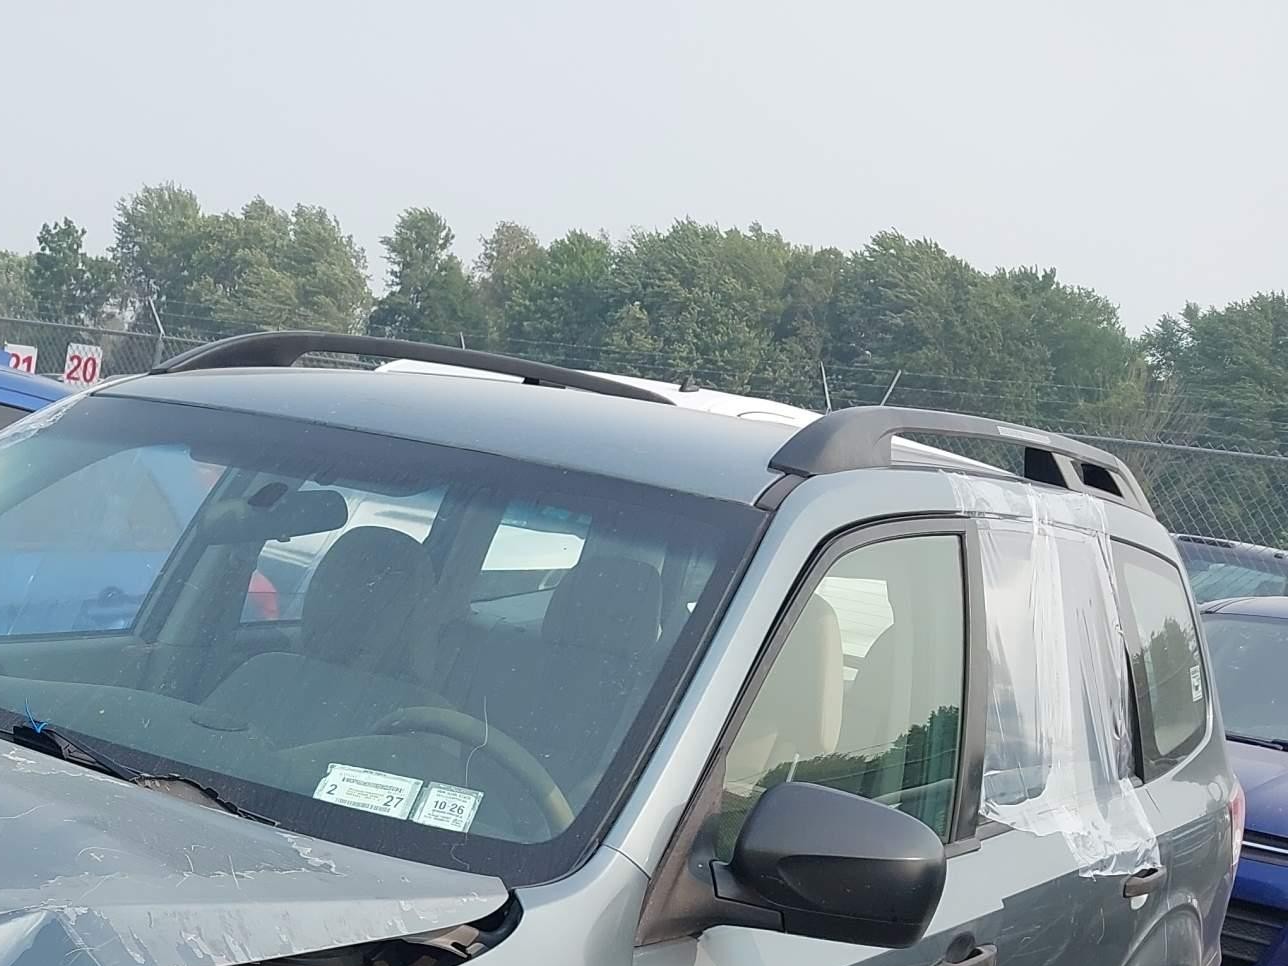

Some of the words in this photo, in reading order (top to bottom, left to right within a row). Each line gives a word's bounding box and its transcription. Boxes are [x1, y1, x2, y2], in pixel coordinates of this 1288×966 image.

[66, 354, 97, 383] 20
[326, 784, 338, 796] 2
[383, 795, 404, 809] 27
